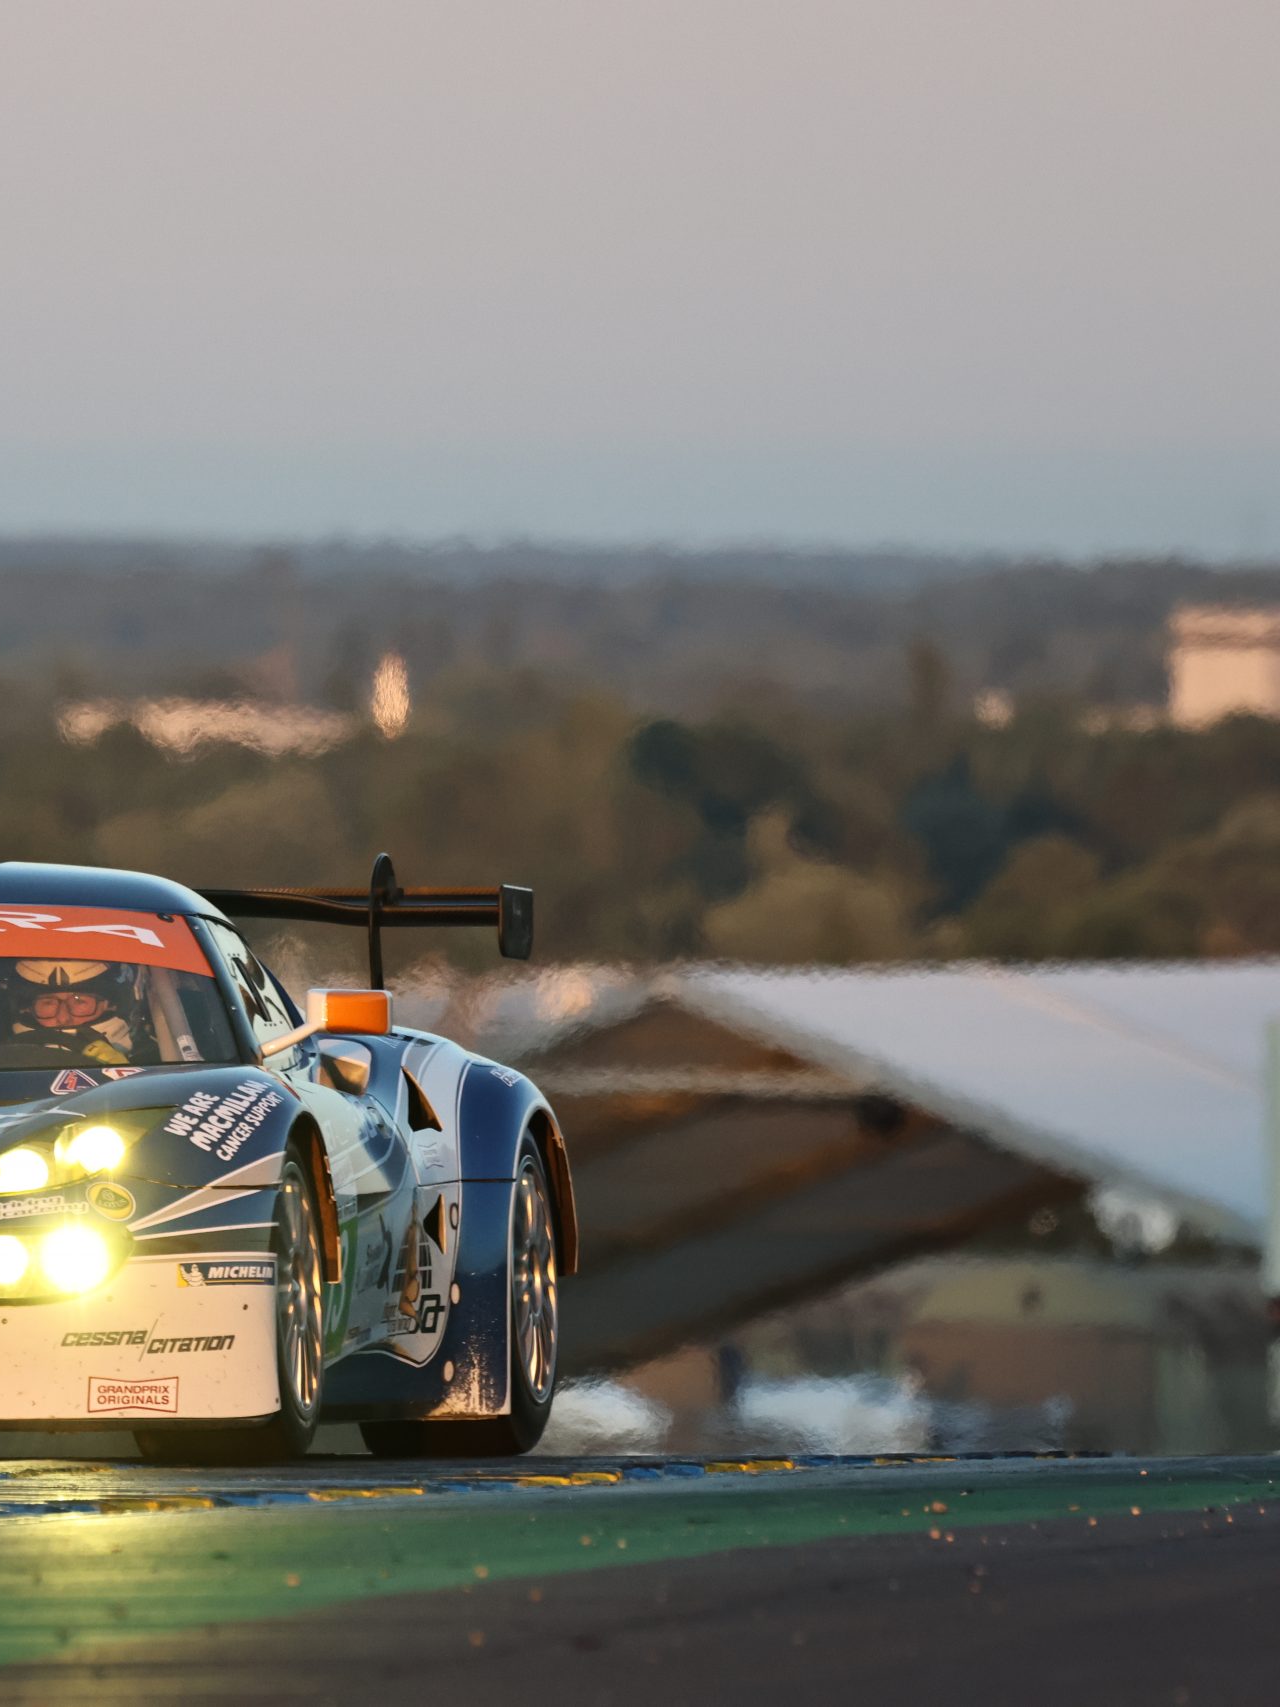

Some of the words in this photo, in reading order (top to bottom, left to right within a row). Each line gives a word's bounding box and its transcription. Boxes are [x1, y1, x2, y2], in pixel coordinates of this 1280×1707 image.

[163, 1112, 200, 1137] WE
[182, 1091, 220, 1117] ARE
[216, 1121, 256, 1161] CANCER
[244, 1091, 285, 1127] SUPPORT
[207, 1265, 274, 1279] MICHELIN
[97, 1384, 170, 1395] GRANDPRIX
[97, 1394, 170, 1406] ORIGINALS
